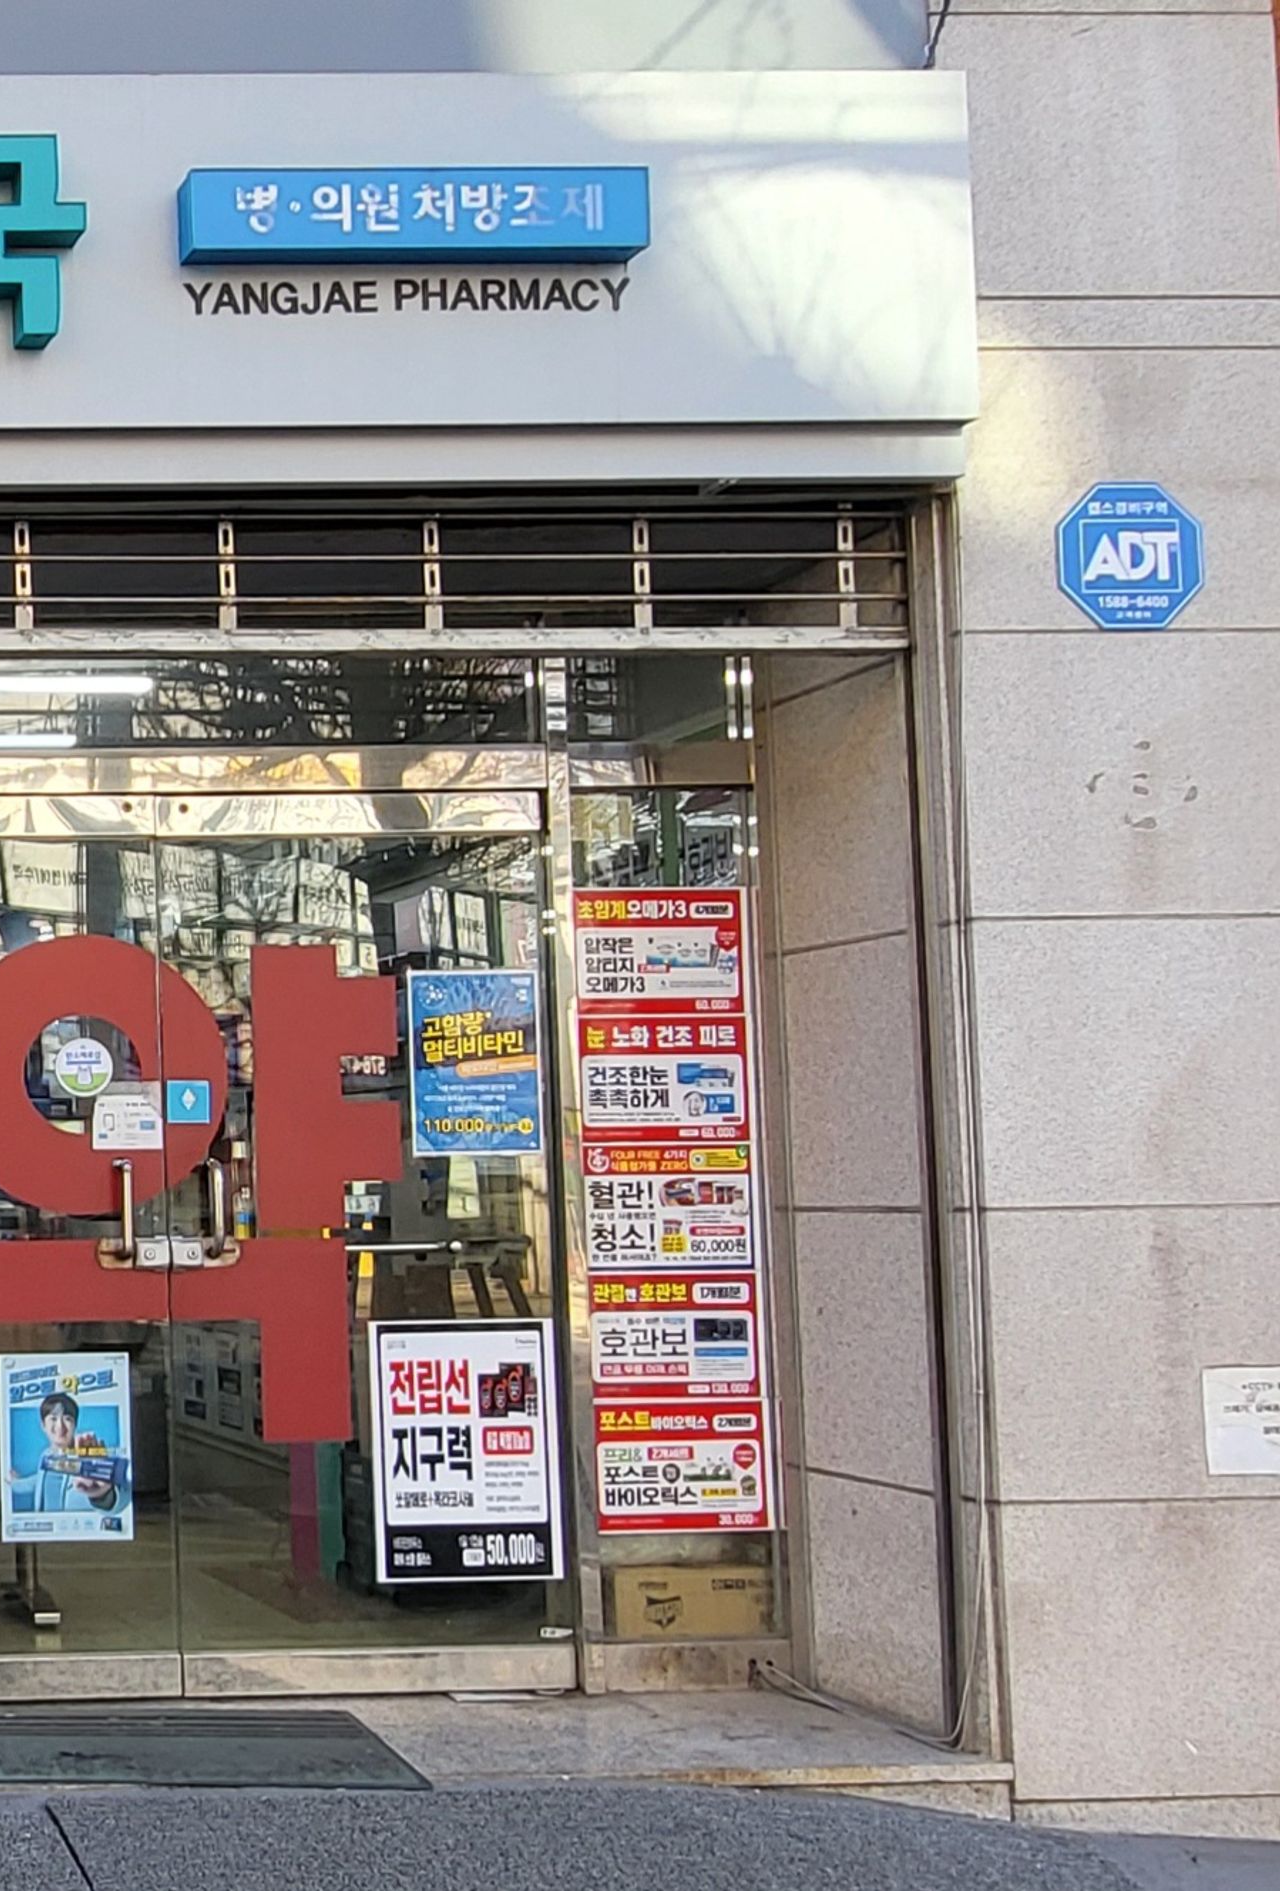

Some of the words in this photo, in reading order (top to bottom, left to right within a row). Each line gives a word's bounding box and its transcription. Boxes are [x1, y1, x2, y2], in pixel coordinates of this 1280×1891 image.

[183, 279, 379, 316] YANGJAE
[394, 277, 630, 312] PHARMACY
[1084, 531, 1179, 581] ADT
[1097, 595, 1169, 608] 1588-6400
[585, 957, 634, 973] 알티지
[586, 976, 646, 993] 오메가3
[422, 1011, 483, 1038] 고함량
[587, 1027, 605, 1048] 눈
[612, 1025, 649, 1048] 노화
[656, 1025, 693, 1048] 건조
[699, 1025, 736, 1047] 피로
[423, 1030, 524, 1063] 멀티비타민
[588, 1066, 668, 1086] 건조한눈
[590, 1089, 669, 1108] 촉촉하게
[588, 1181, 654, 1209] 혈관!
[591, 1224, 655, 1252] 청소!
[639, 1282, 687, 1302] 호관보
[600, 1328, 688, 1357] 호관보
[389, 1359, 471, 1416] 전립선
[392, 1425, 473, 1482] 지구력
[604, 1465, 659, 1485] 포스트
[605, 1487, 698, 1507] 바이오틱스
